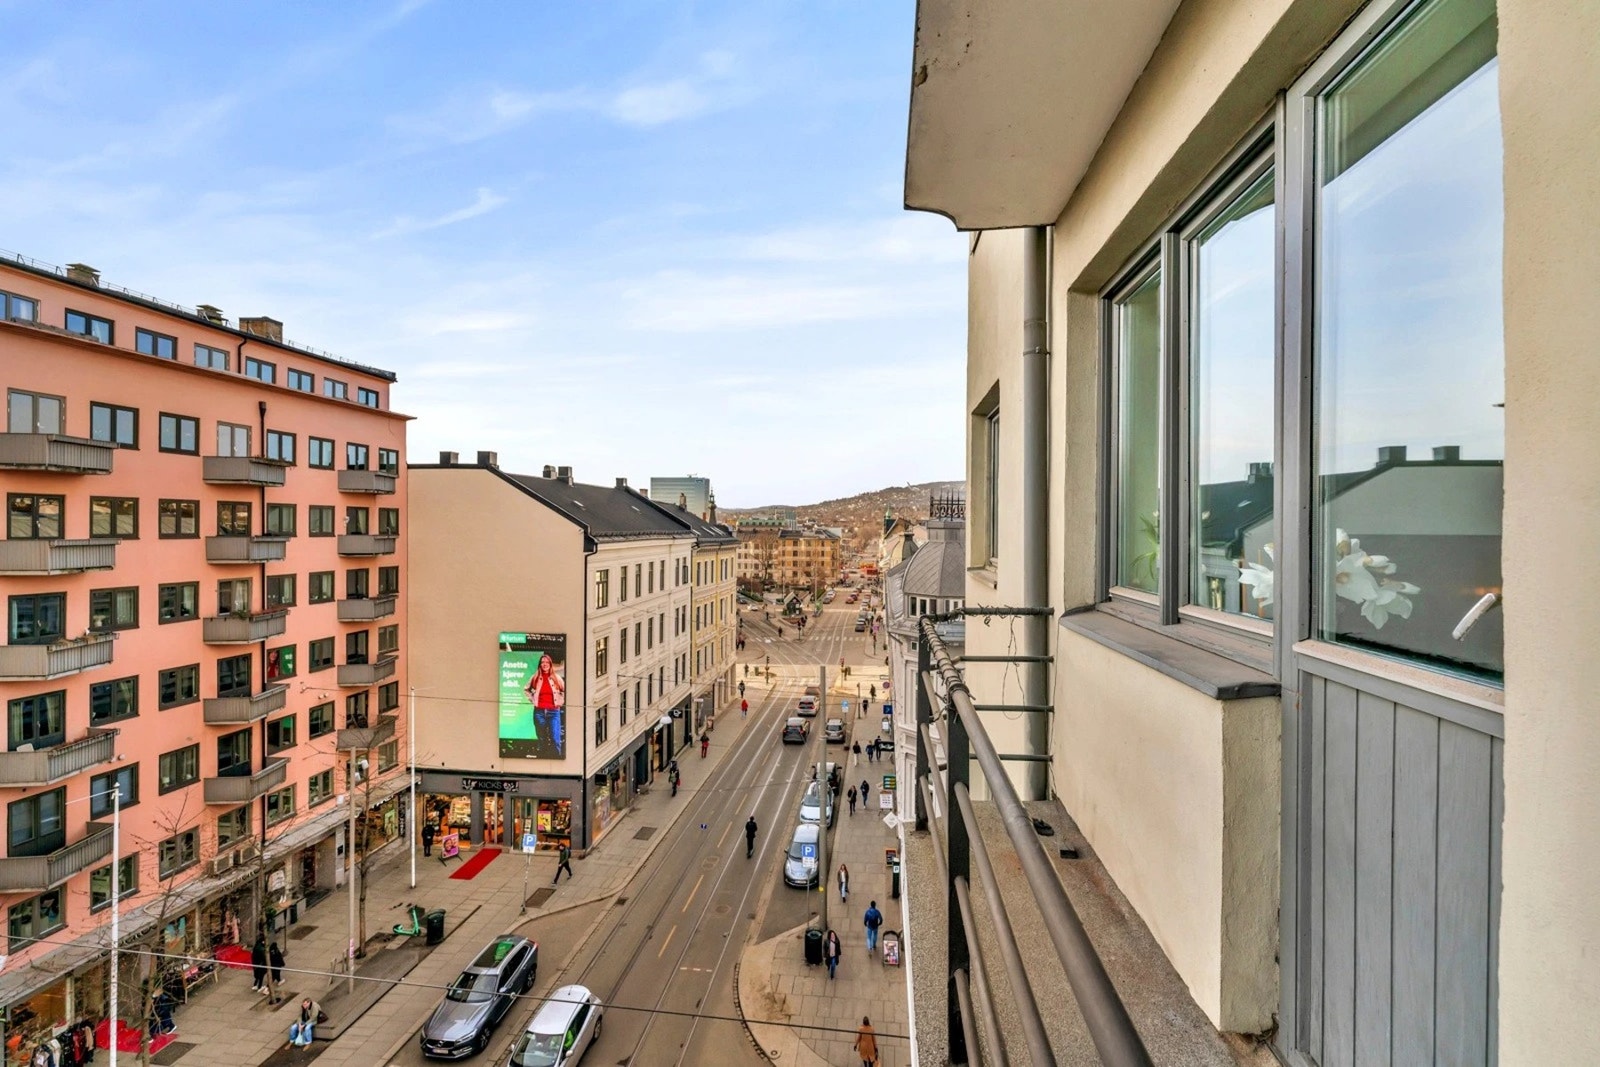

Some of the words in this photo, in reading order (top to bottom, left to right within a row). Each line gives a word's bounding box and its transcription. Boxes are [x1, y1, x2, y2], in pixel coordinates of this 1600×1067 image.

[478, 781, 502, 789] KICKS
[526, 836, 533, 845] P
[805, 846, 812, 856] P
